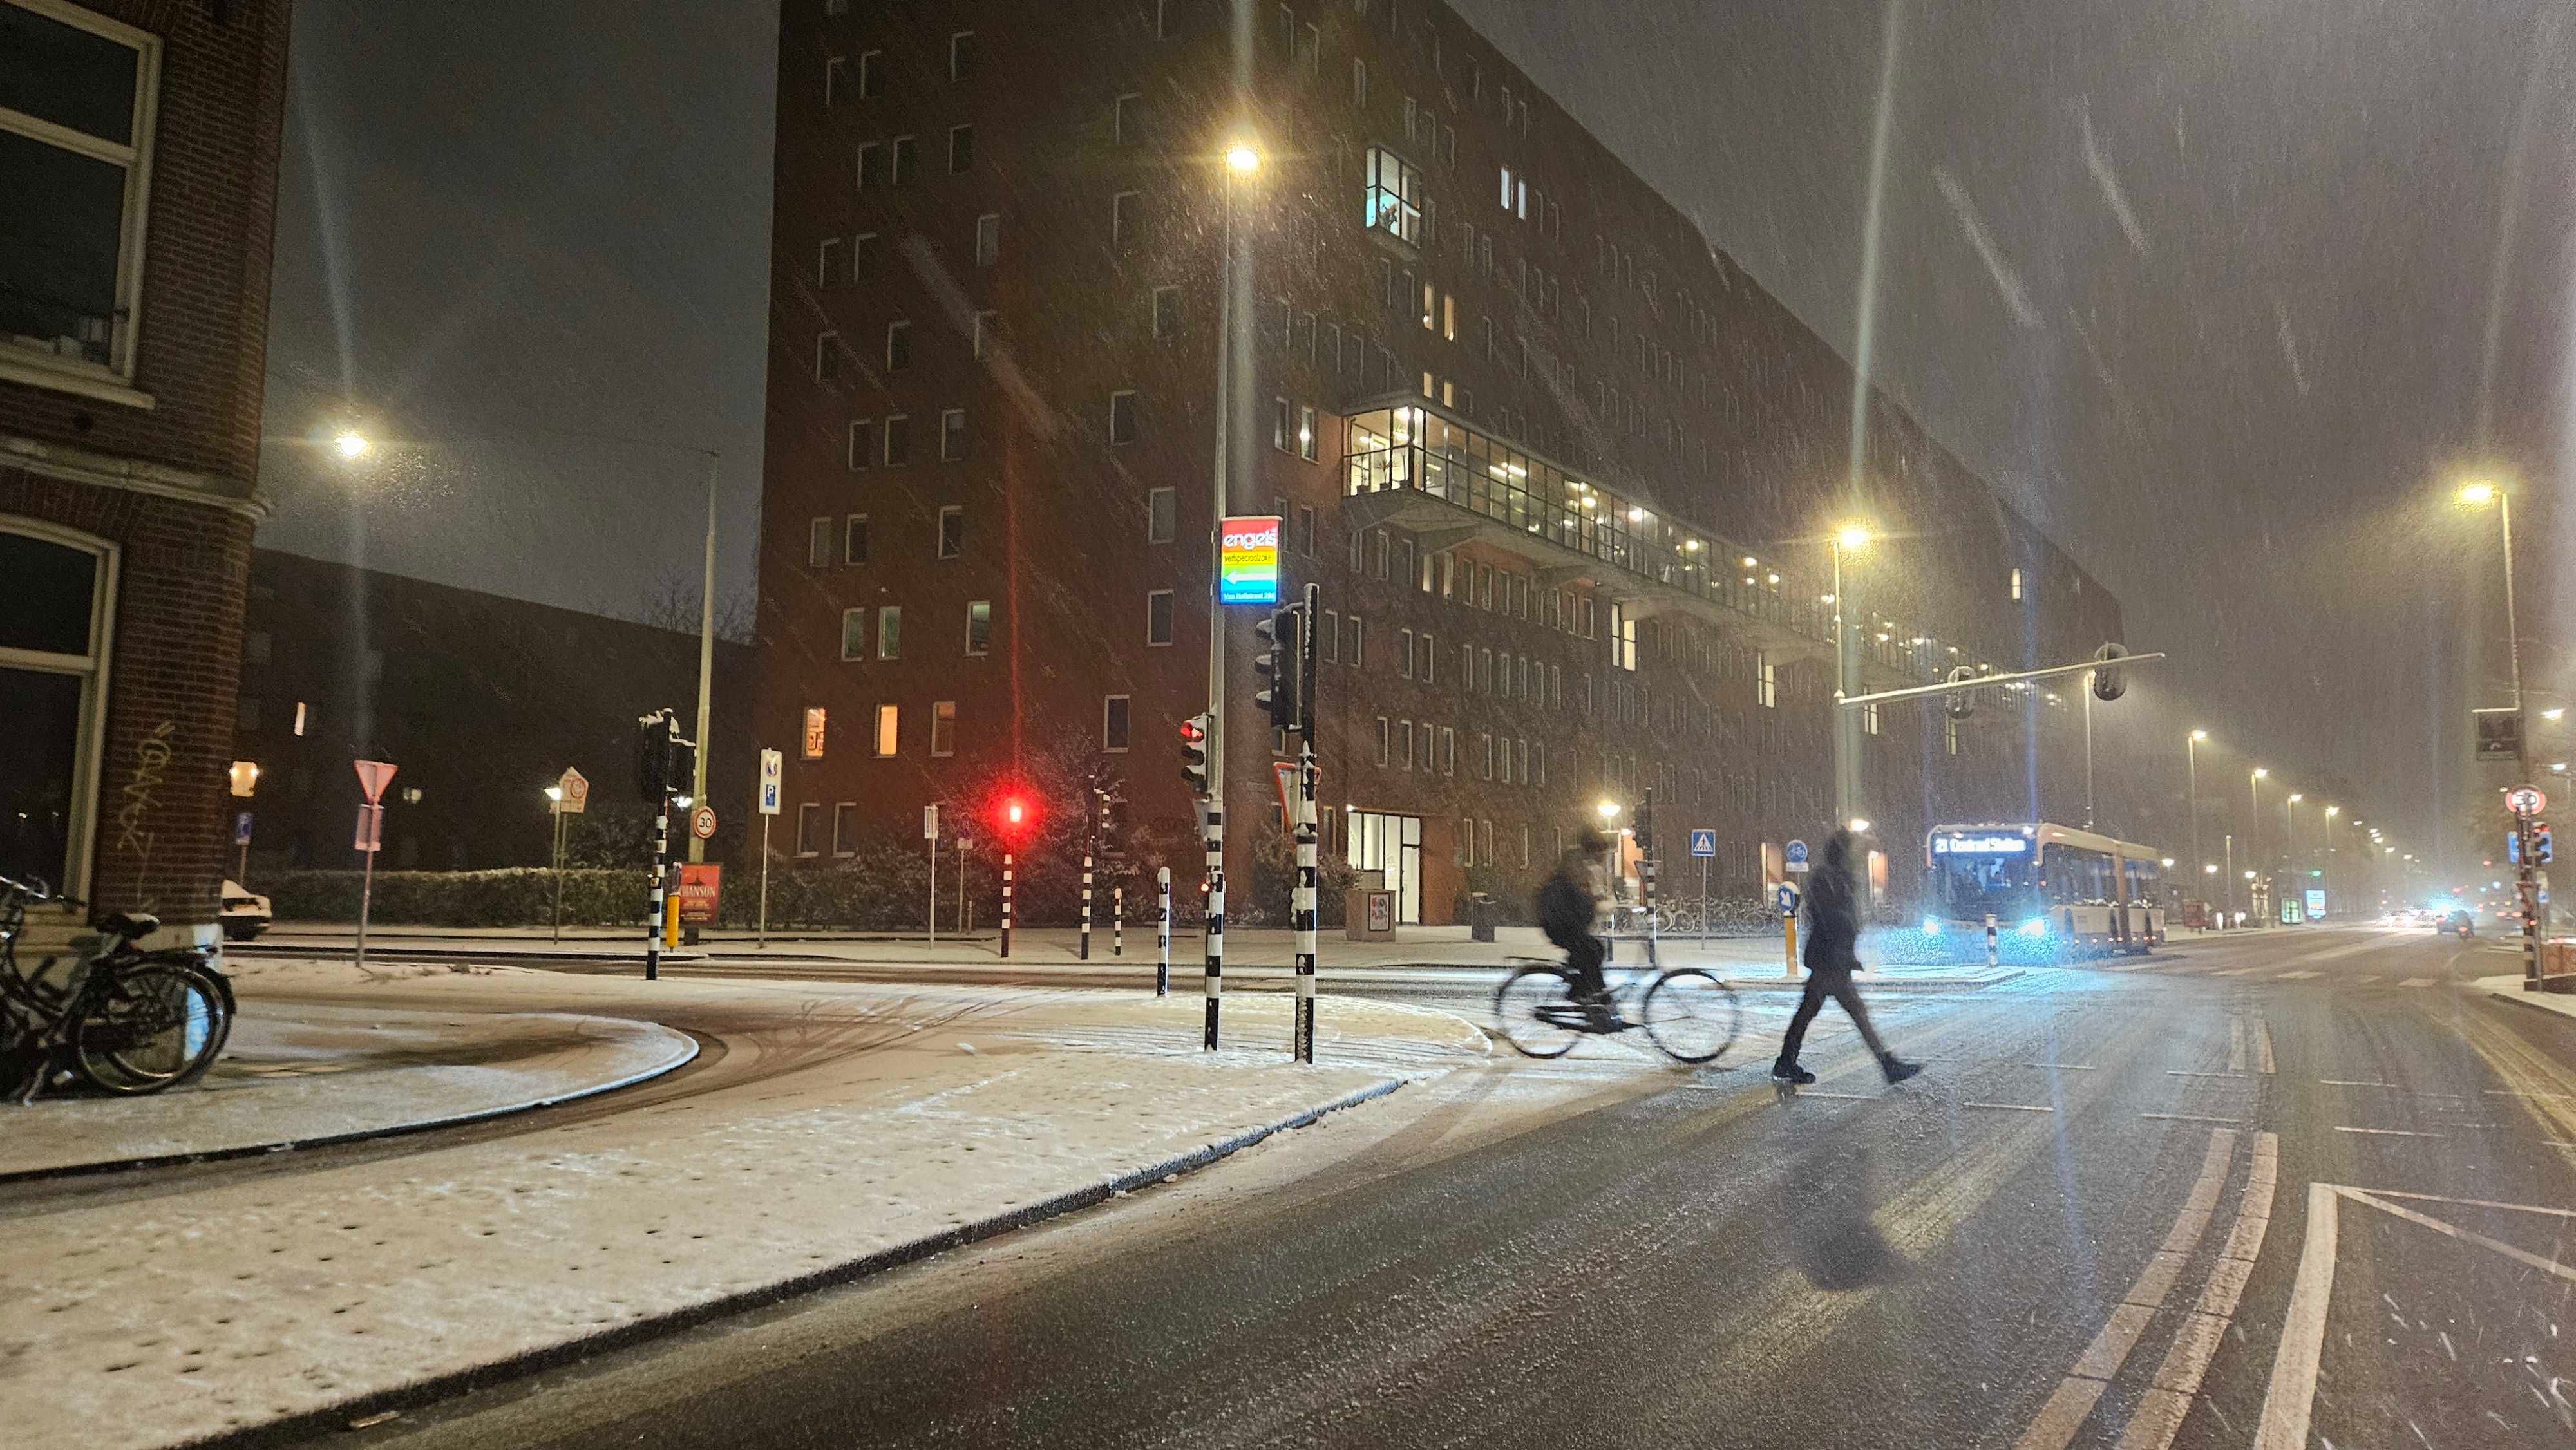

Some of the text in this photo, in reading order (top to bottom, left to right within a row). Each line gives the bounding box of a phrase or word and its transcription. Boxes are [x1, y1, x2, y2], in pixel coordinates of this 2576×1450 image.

[1224, 528, 1277, 551] engels
[2515, 794, 2537, 805] 30
[699, 817, 712, 828] 30
